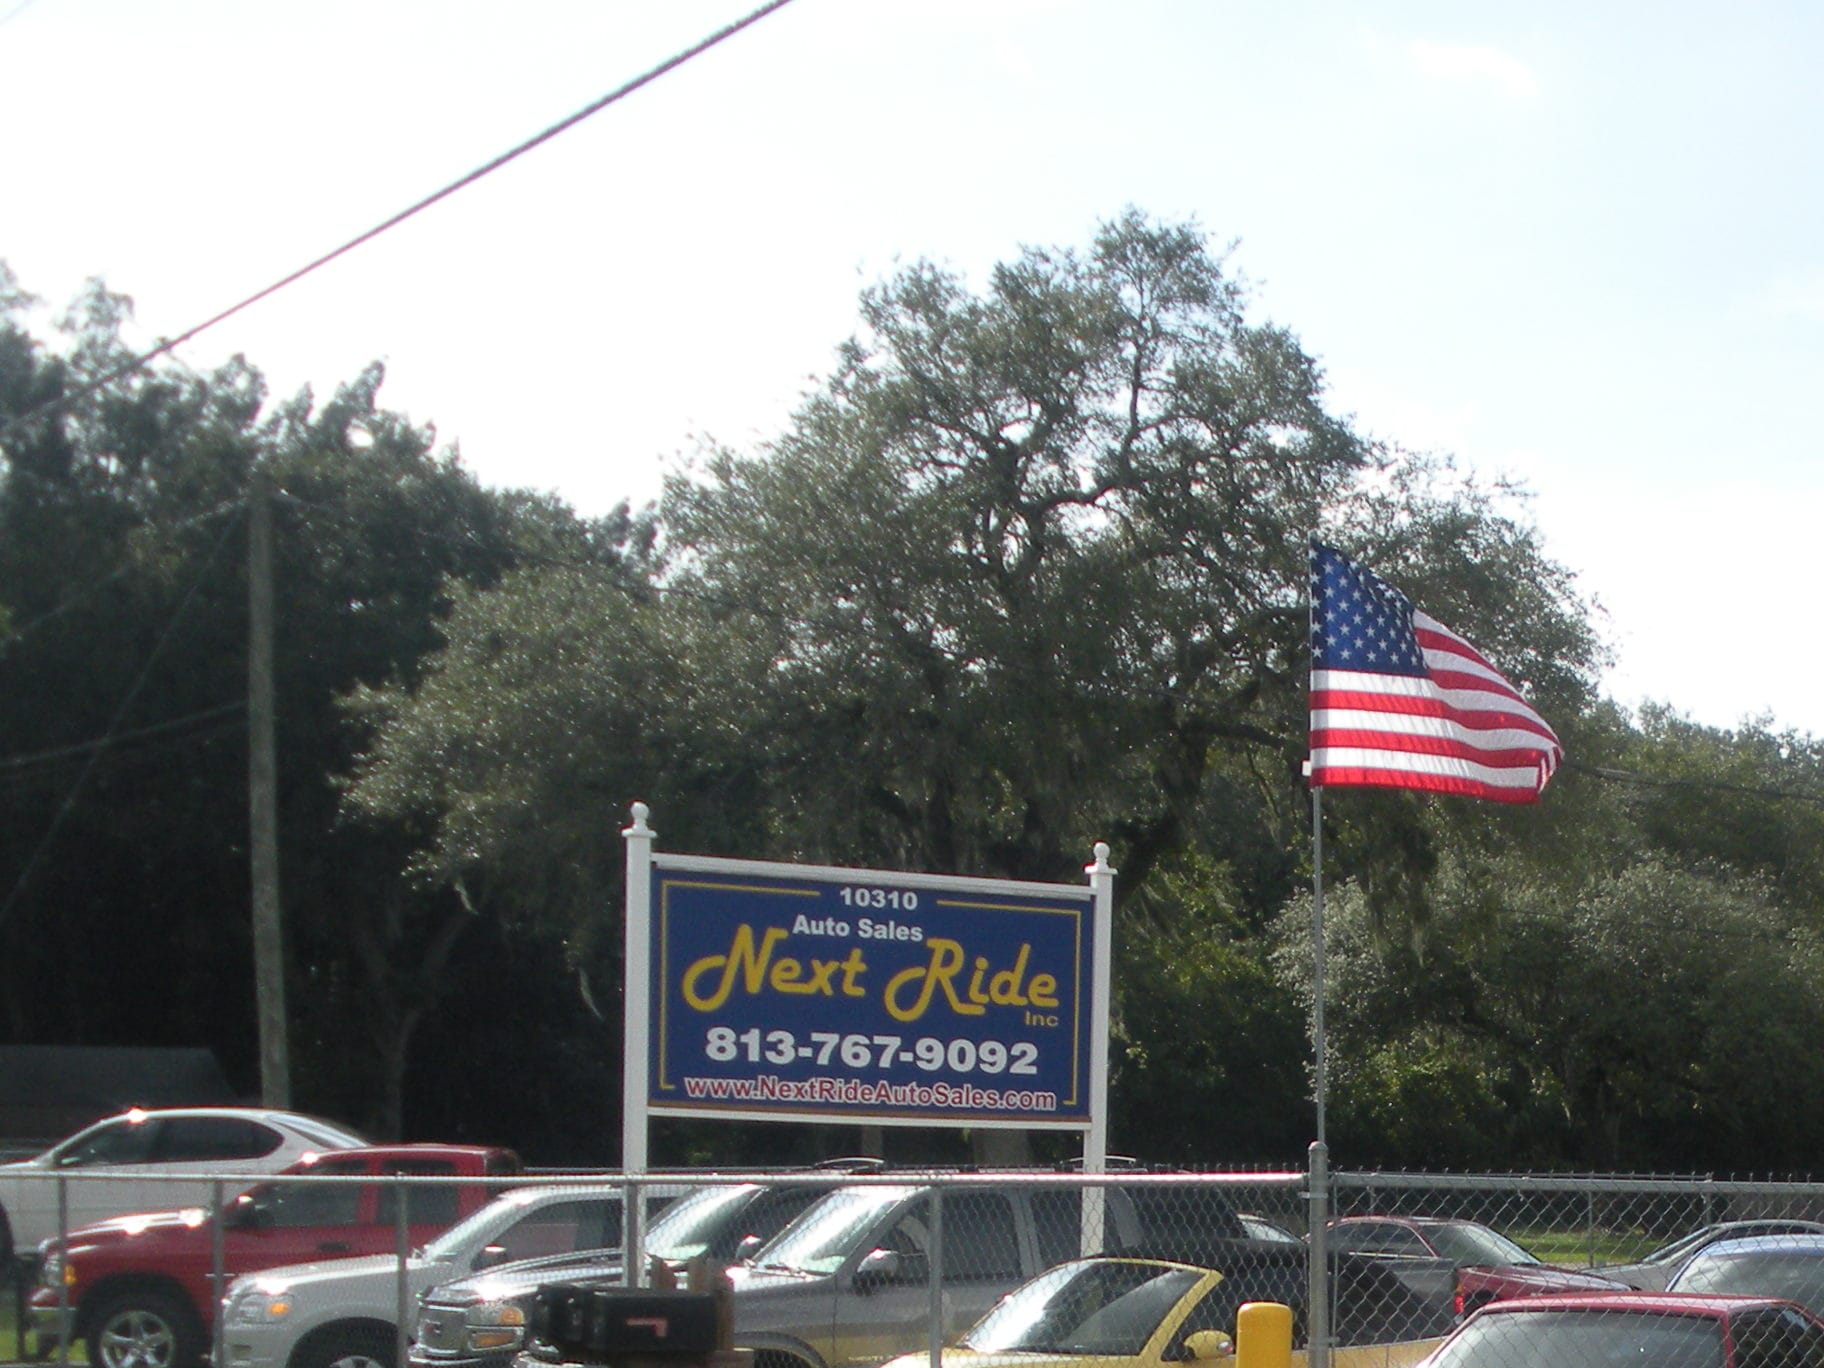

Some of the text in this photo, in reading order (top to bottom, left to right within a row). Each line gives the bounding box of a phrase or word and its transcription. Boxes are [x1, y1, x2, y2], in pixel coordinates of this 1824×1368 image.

[839, 887, 918, 911] 10310
[792, 914, 924, 943] Auto Sales
[682, 924, 1060, 1022] Next Ride
[1024, 1010, 1059, 1028] Inc
[704, 1026, 1039, 1076] 813-767-9092
[684, 1074, 1057, 1111] www.NextRideAutoSales.com
